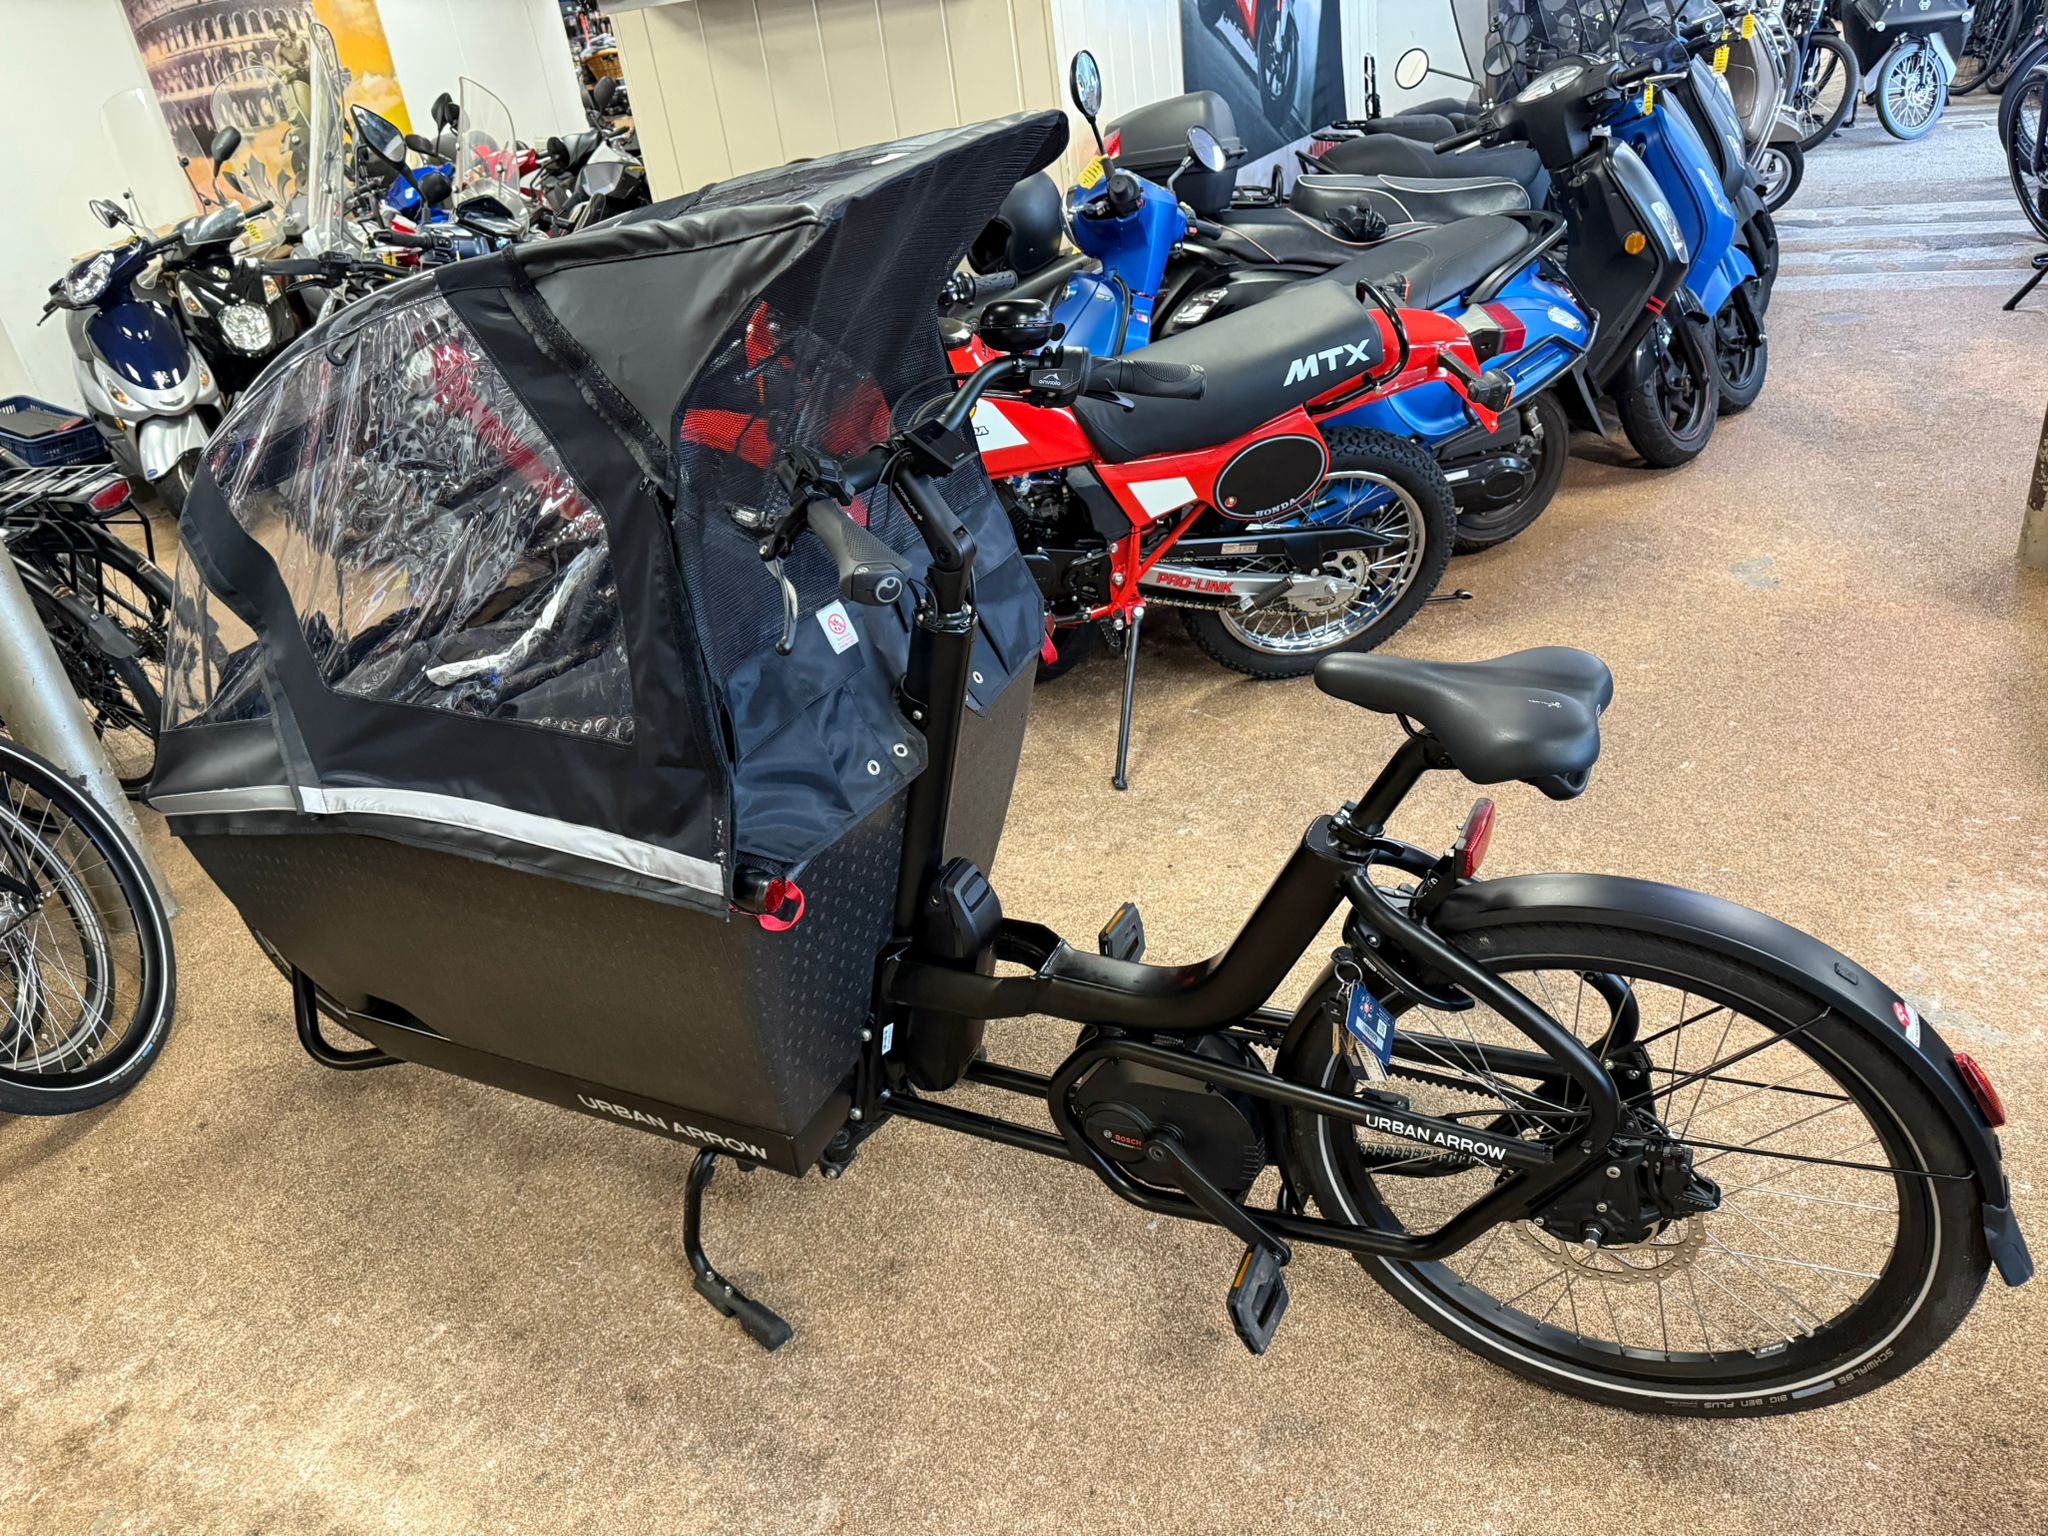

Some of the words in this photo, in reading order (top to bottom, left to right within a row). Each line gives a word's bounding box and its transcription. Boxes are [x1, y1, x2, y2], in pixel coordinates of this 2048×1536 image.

[1283, 338, 1371, 387] MTX
[1255, 497, 1297, 518] HONDA
[1156, 572, 1233, 593] PRO-LINK
[577, 1094, 668, 1130] URBAN
[673, 1122, 767, 1159] ARROW
[1114, 1134, 1142, 1147] BOSCH
[1365, 1114, 1430, 1142] URBAN
[1433, 1131, 1506, 1161] ARROW
[1837, 1347, 1895, 1385] SCHWALBE
[1703, 1401, 1735, 1409] PLUS
[1769, 1394, 1788, 1404] BIG
